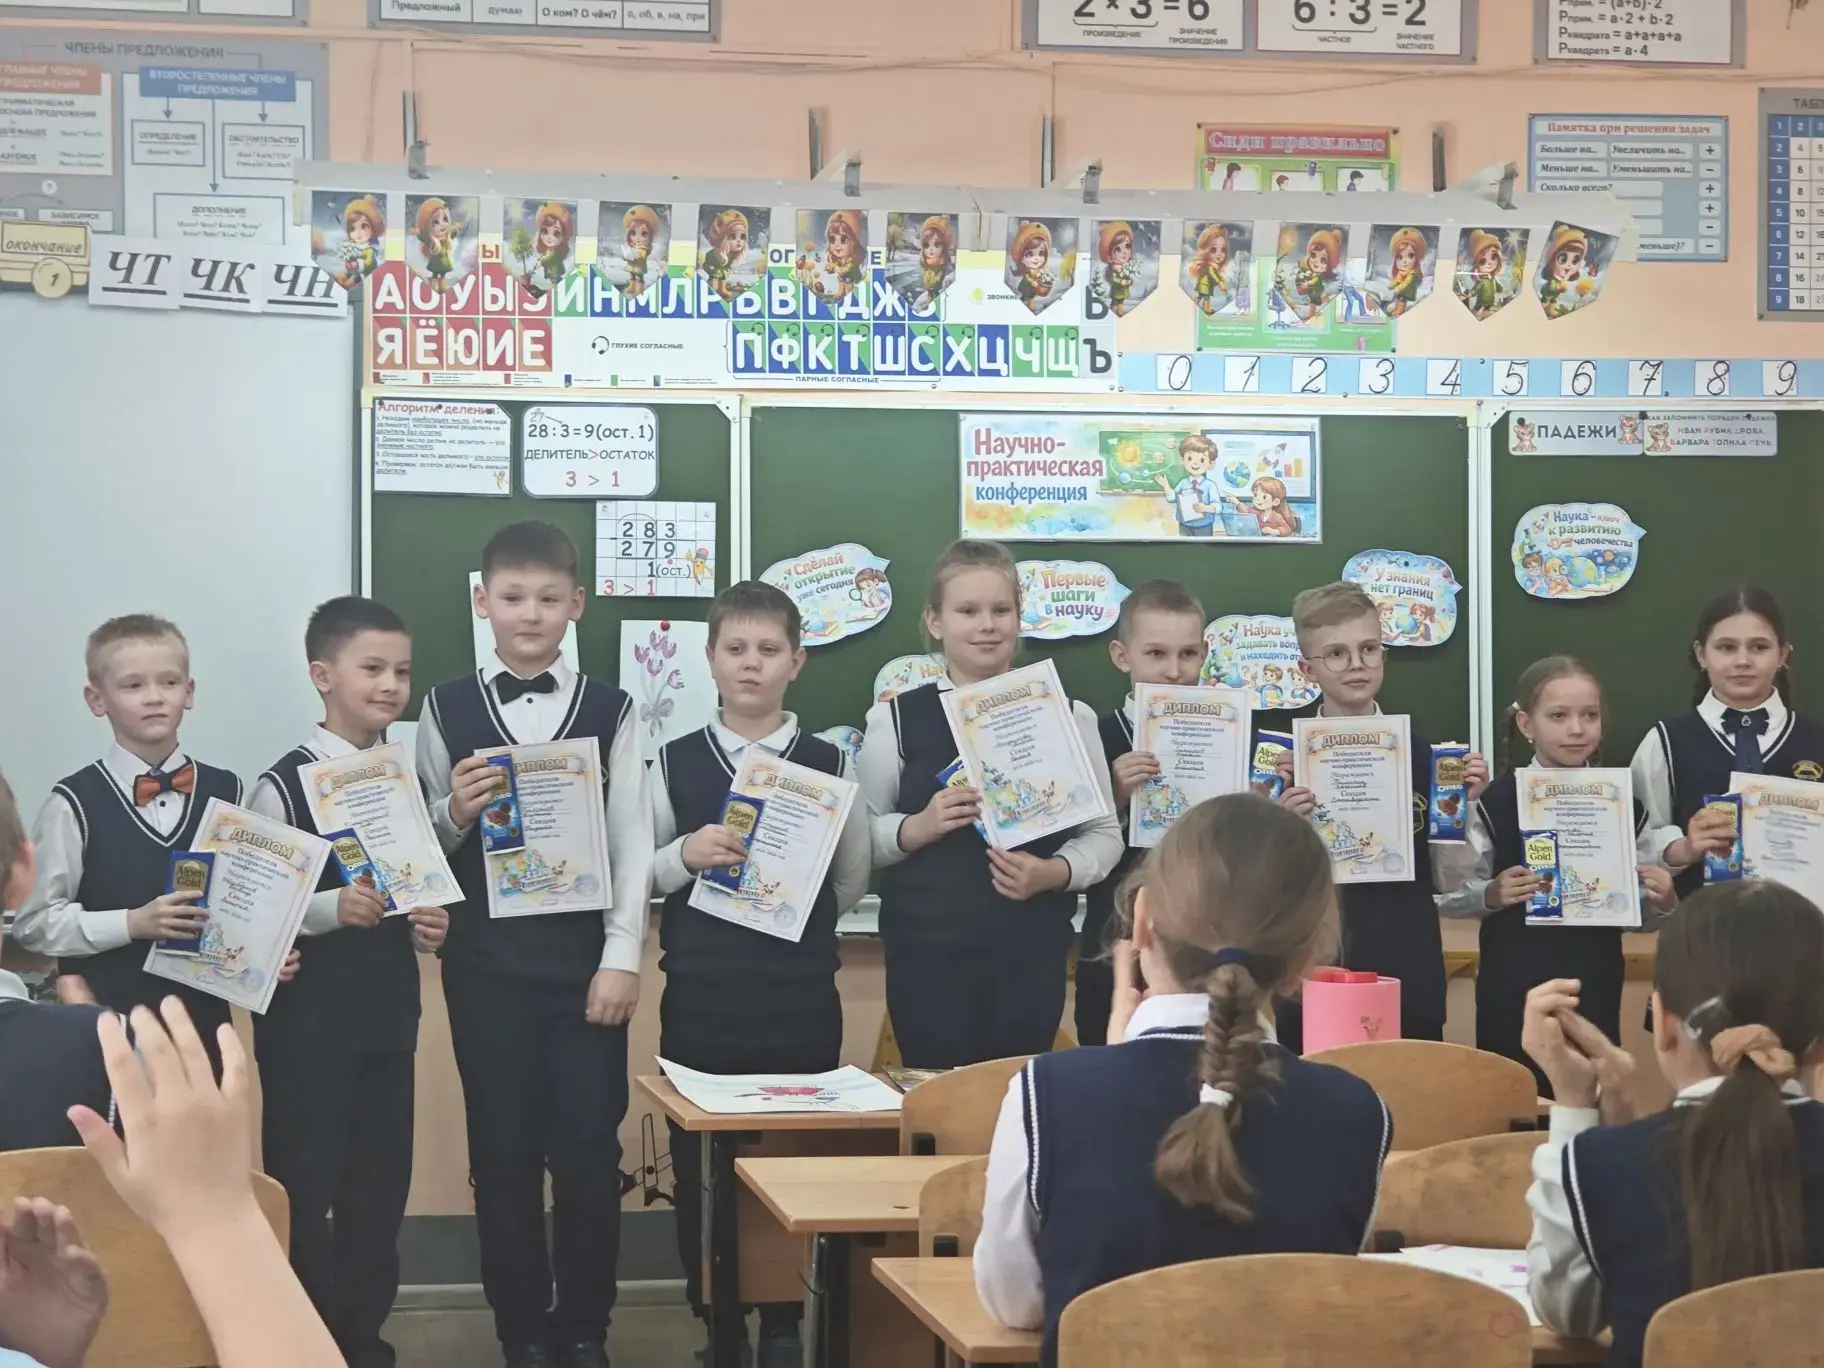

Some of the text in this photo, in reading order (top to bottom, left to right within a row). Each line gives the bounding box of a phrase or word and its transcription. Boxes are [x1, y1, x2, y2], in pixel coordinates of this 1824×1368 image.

[64, 43, 224, 59] ЧЛЕНЫ ПРЕДЛОЖЕНИЯ
[1547, 121, 1597, 134] Памятка
[1270, 135, 1386, 154] правильно
[107, 251, 172, 285] ЧТ
[190, 257, 256, 295] ЧК
[273, 263, 335, 299] ЧН
[374, 272, 405, 310] А
[484, 274, 514, 312] Ы
[376, 319, 546, 367] Я Ё Ю И Е
[611, 342, 638, 350] ГЛУХИЕ
[736, 332, 1113, 378] П Ф К Т Ш С Х Ц Ч Щ Ъ
[1168, 355, 1798, 397] 0 1 2 3 4 5 6 7 8 9
[1537, 424, 1618, 440] ПАДЕЖИ
[974, 428, 1066, 458] Научно-
[565, 470, 577, 488] 3
[611, 470, 620, 488] 1
[966, 459, 1104, 481] практическая
[975, 482, 1088, 505] конференция
[1553, 510, 1590, 524] Наука
[1558, 524, 1622, 537] развитию
[1574, 538, 1634, 548] человечества
[793, 552, 845, 576] Сделай
[794, 565, 856, 590] открытие
[815, 578, 855, 594] сегодня
[1041, 569, 1107, 590] Первые
[1386, 570, 1432, 587] знания
[603, 578, 615, 596] 3
[647, 578, 656, 596] 1
[1051, 589, 1096, 603] шаги
[1370, 583, 1435, 602] нет границ
[1044, 603, 1105, 621] в науку
[1243, 623, 1282, 639] Наука
[1236, 640, 1279, 650] задавать
[1247, 652, 1289, 661] находить
[1163, 701, 1222, 716] ДИПЛОМ
[1322, 732, 1381, 749] ДИПЛОМ
[1545, 784, 1603, 796] ДИПЛОМ
[230, 826, 296, 860] ДИПЛОМ
[1528, 843, 1553, 856] Alpen
[1529, 851, 1552, 862] Gold
